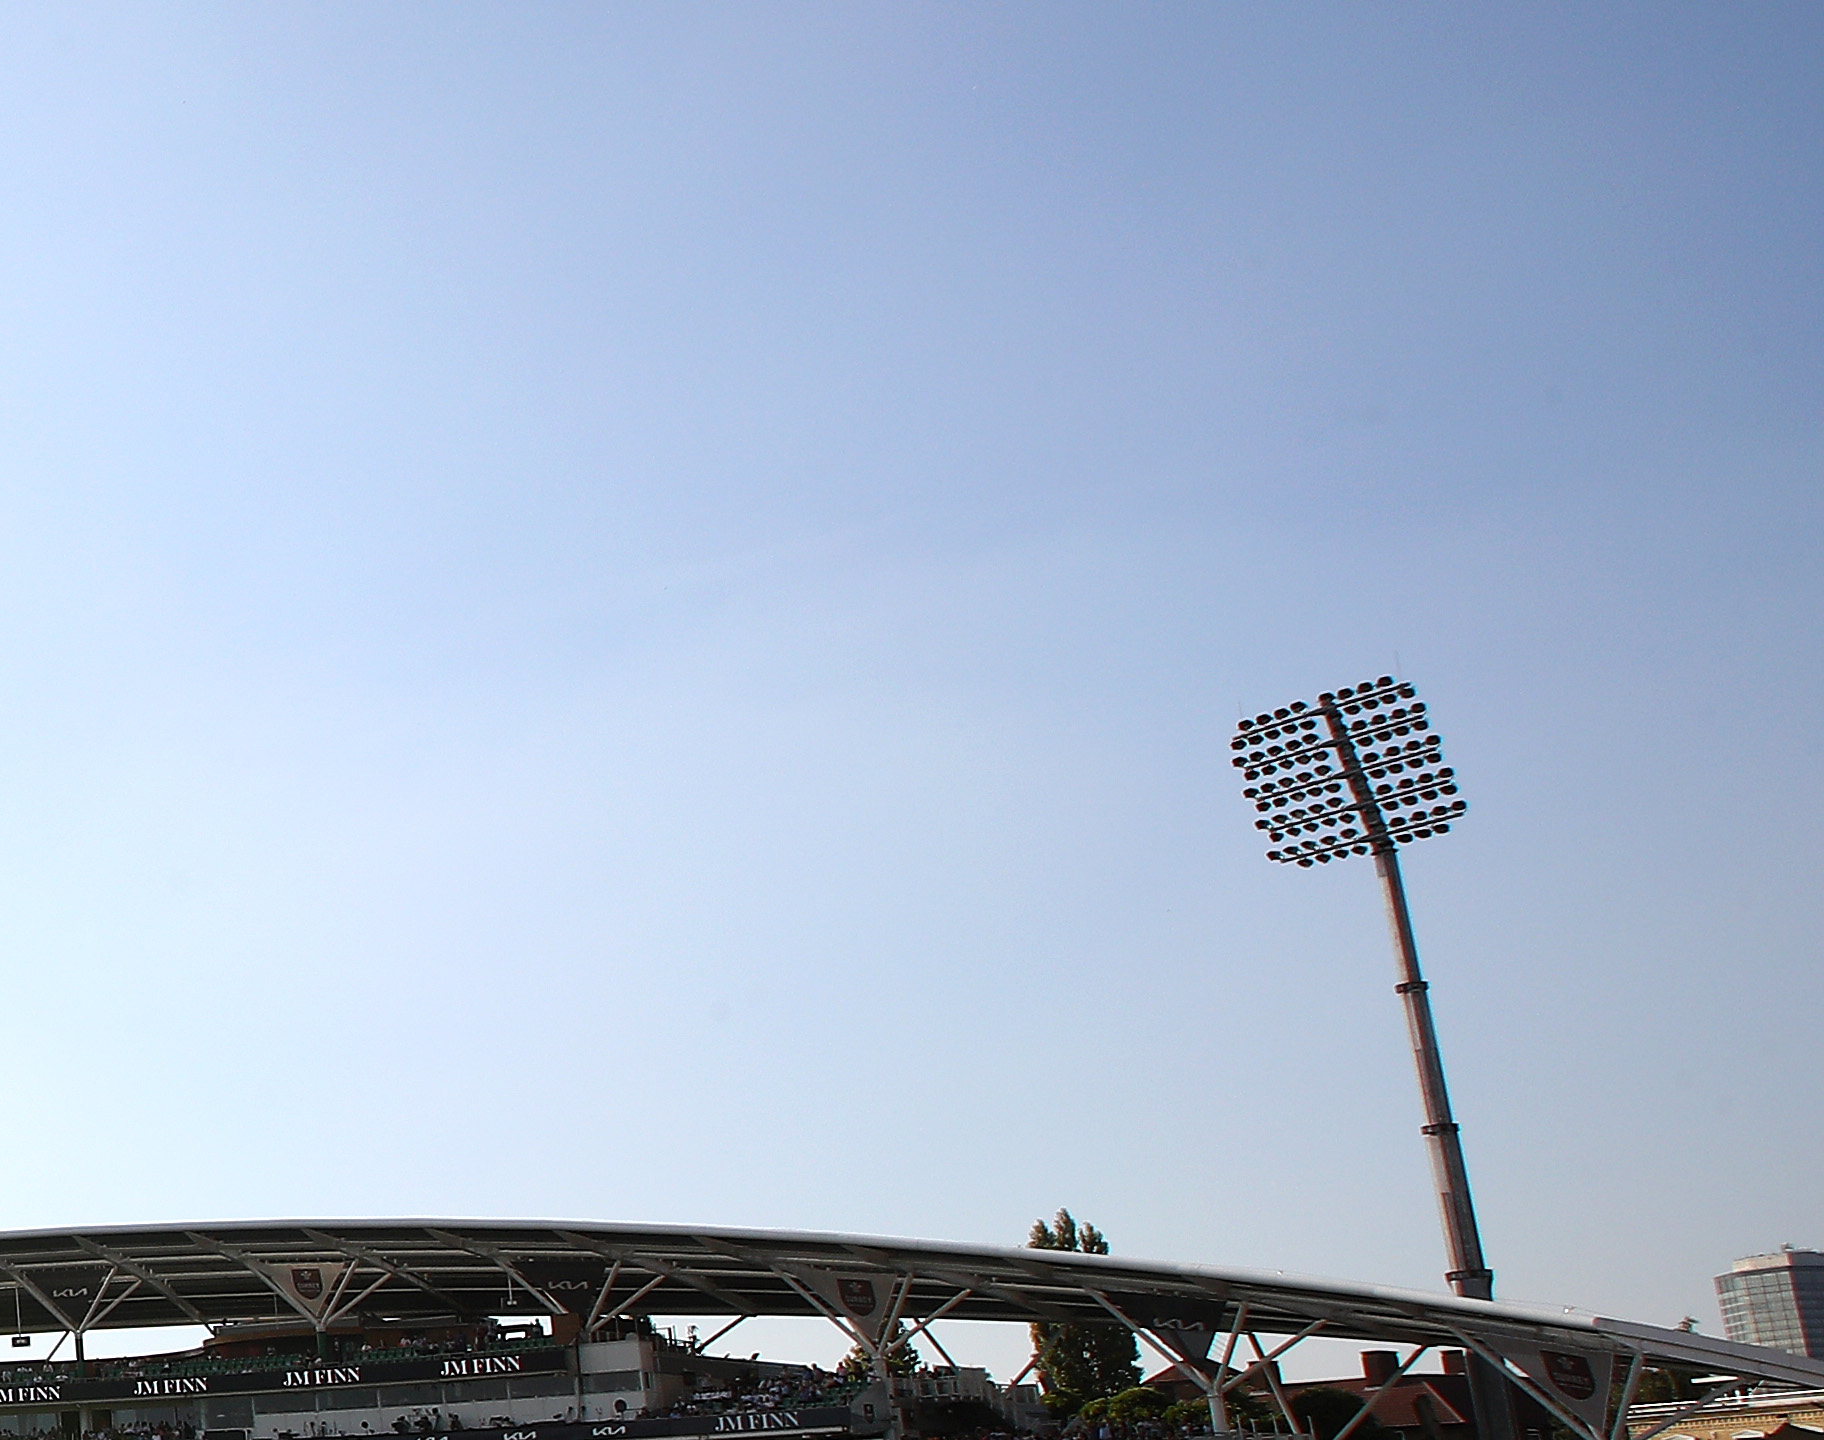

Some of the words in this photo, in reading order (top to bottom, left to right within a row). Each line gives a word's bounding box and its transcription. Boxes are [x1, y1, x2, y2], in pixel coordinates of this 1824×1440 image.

[440, 1360, 468, 1376] JM
[473, 1356, 521, 1374] FINN
[134, 1380, 160, 1395] JM
[164, 1377, 208, 1394] FINN
[283, 1371, 310, 1387] JM
[315, 1367, 361, 1385] FINN
[19, 1386, 61, 1401] FINN
[593, 1425, 626, 1436] KIA
[715, 1416, 743, 1432] JM
[746, 1411, 800, 1430] FINN
